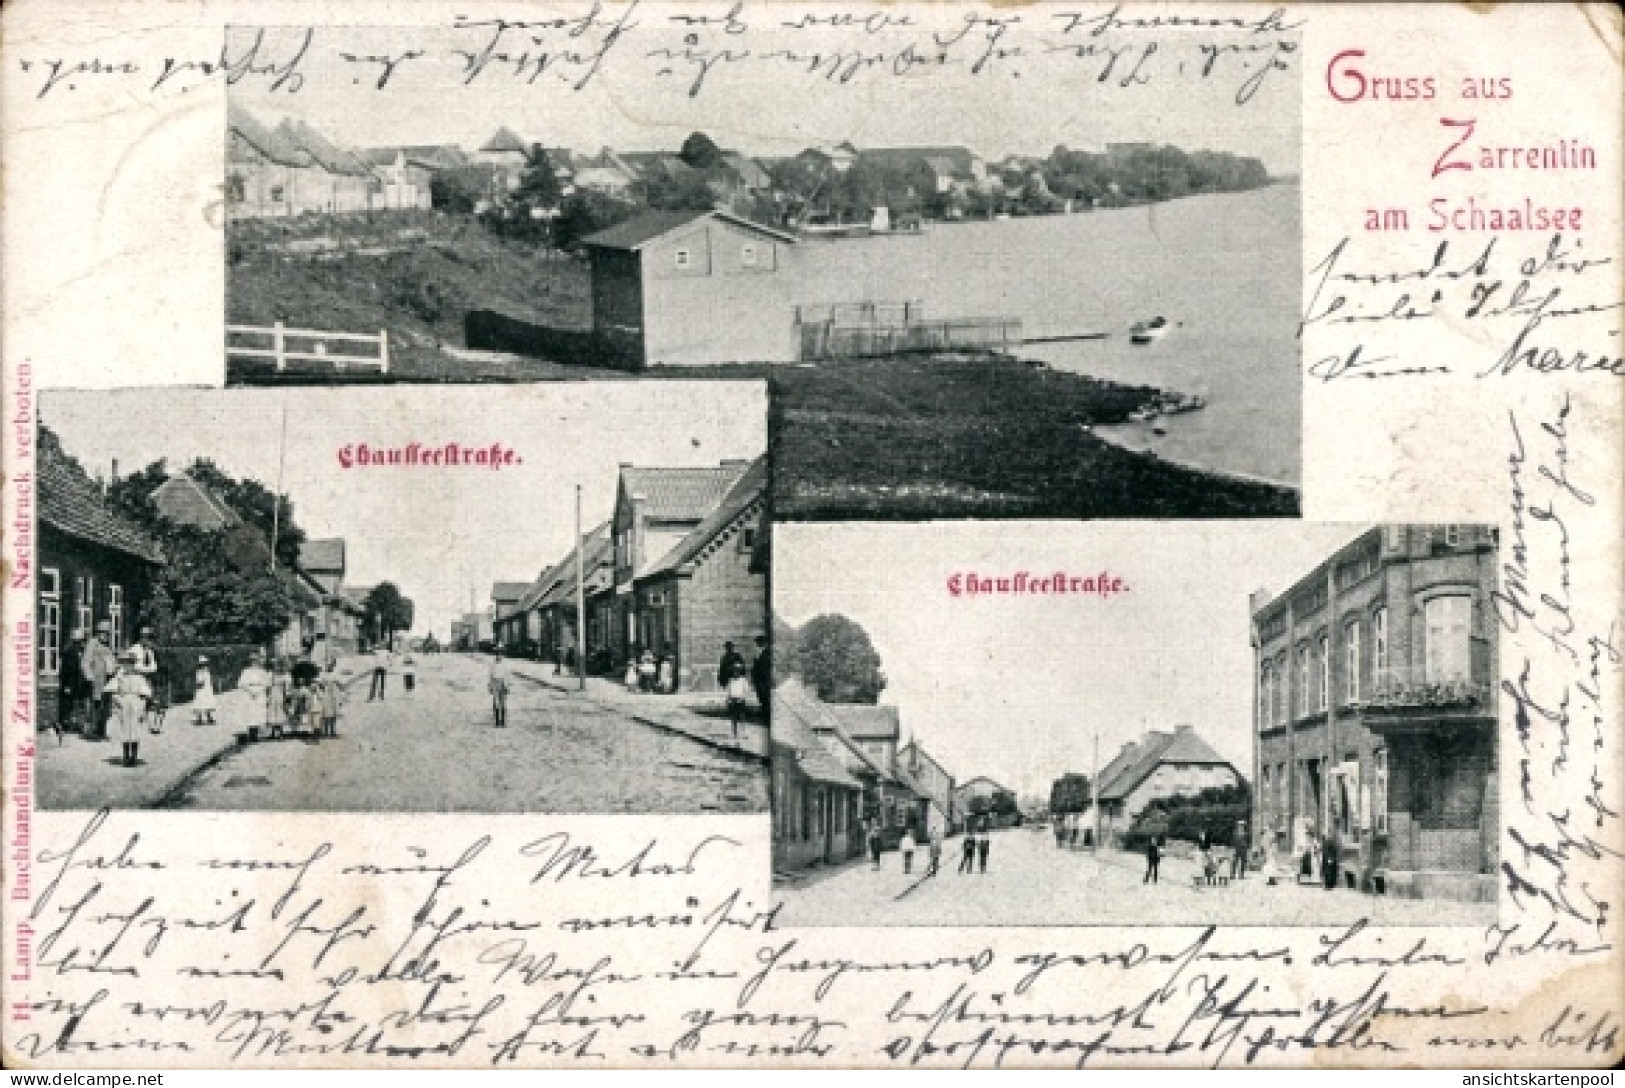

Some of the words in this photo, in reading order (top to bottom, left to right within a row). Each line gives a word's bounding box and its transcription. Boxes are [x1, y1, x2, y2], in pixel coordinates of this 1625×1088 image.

[1326, 50, 1436, 103] Gruss
[1461, 77, 1513, 99] aus
[1432, 118, 1597, 179] Zarrentin
[1365, 208, 1409, 231] am
[1428, 197, 1583, 232] Schaalsee
[12, 357, 31, 459] verboten.
[10, 473, 31, 590] Nachdruck
